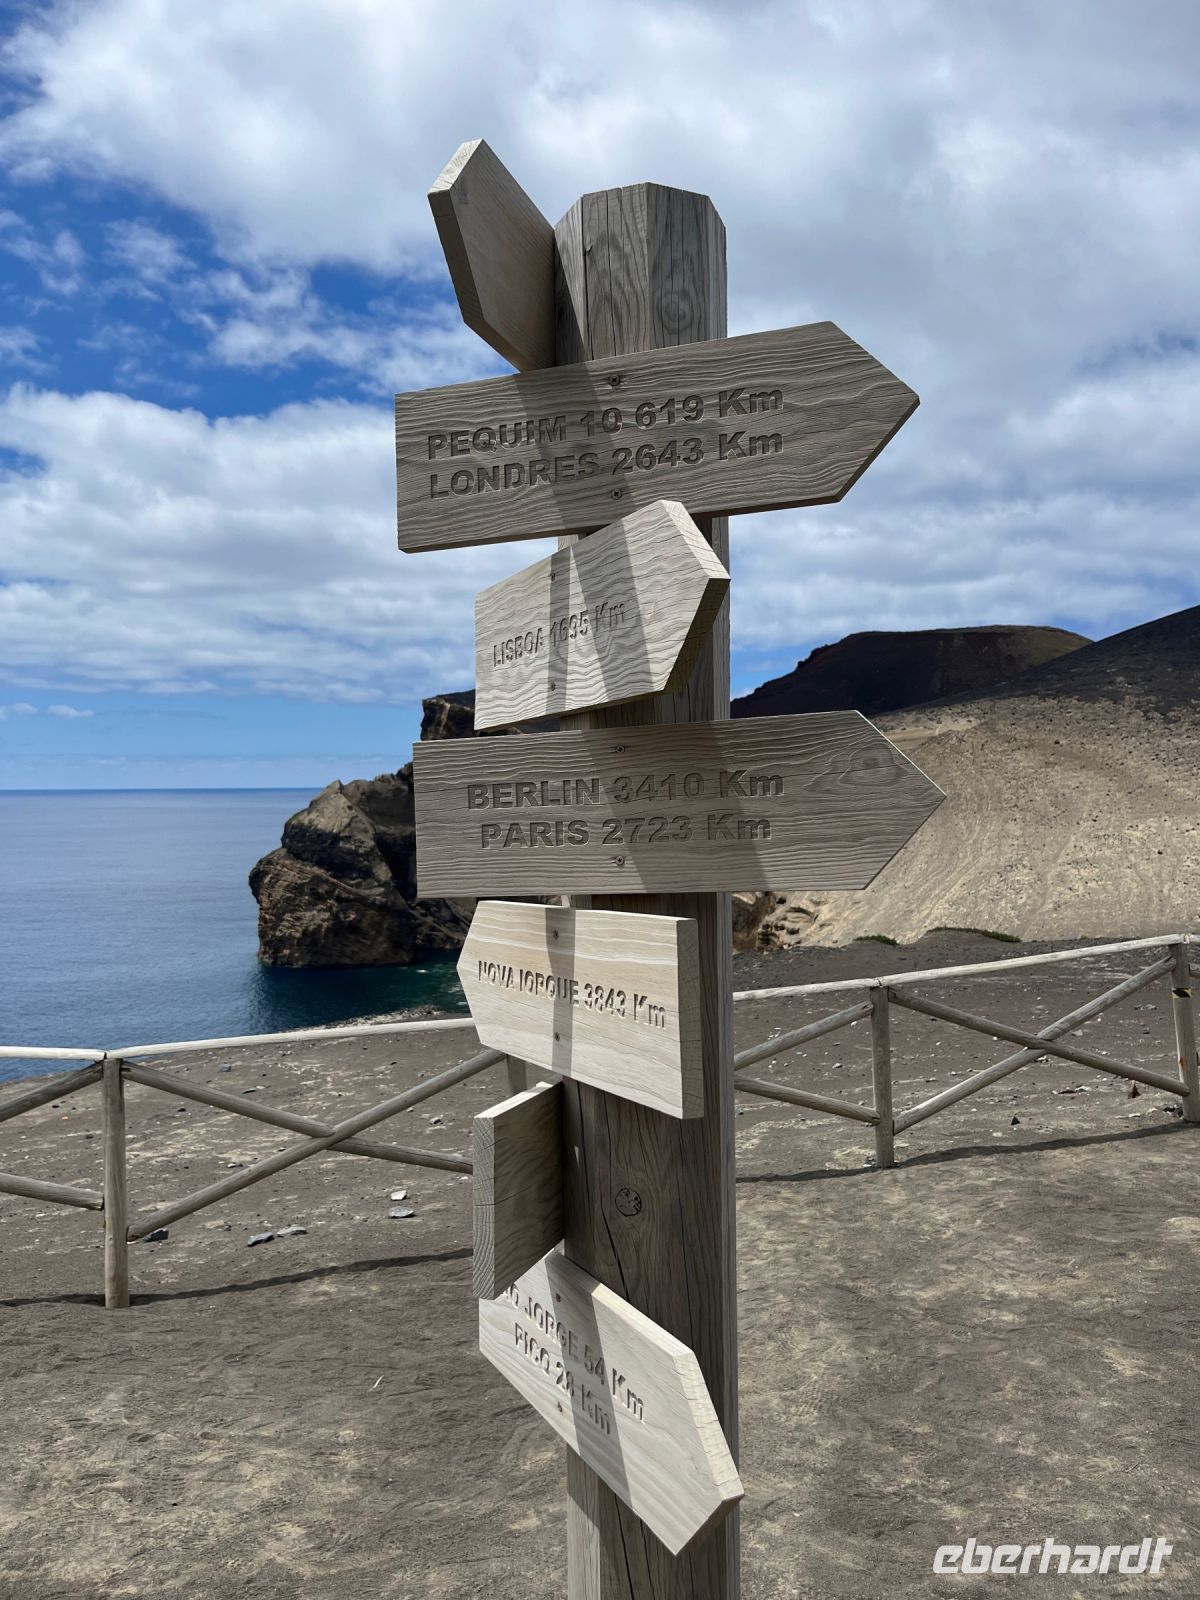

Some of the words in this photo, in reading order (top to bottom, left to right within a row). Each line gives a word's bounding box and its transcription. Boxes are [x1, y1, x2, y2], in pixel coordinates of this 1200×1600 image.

[428, 415, 567, 460] PEQUIM
[580, 407, 623, 437] 10
[635, 395, 705, 430] 619
[718, 387, 784, 418] Km
[429, 452, 600, 499] LONDRES
[612, 437, 705, 476] 2643
[718, 431, 784, 461] Km
[493, 627, 543, 667] LISBOA
[595, 601, 625, 632] Km
[467, 778, 600, 810] BERLIN
[613, 772, 704, 802] 3410
[719, 769, 785, 798] Km
[481, 819, 590, 850] PARIS
[602, 816, 692, 845] 2723
[707, 813, 772, 841] Km
[478, 960, 515, 989] NOVA
[519, 968, 579, 1007] IORQUE
[584, 983, 627, 1019] 3843
[633, 993, 666, 1029] Km
[515, 1322, 550, 1376] PICO
[581, 1384, 611, 1435] Km
[524, 1295, 579, 1360] JORGE
[584, 1344, 605, 1385] 54
[612, 1367, 644, 1424] Km
